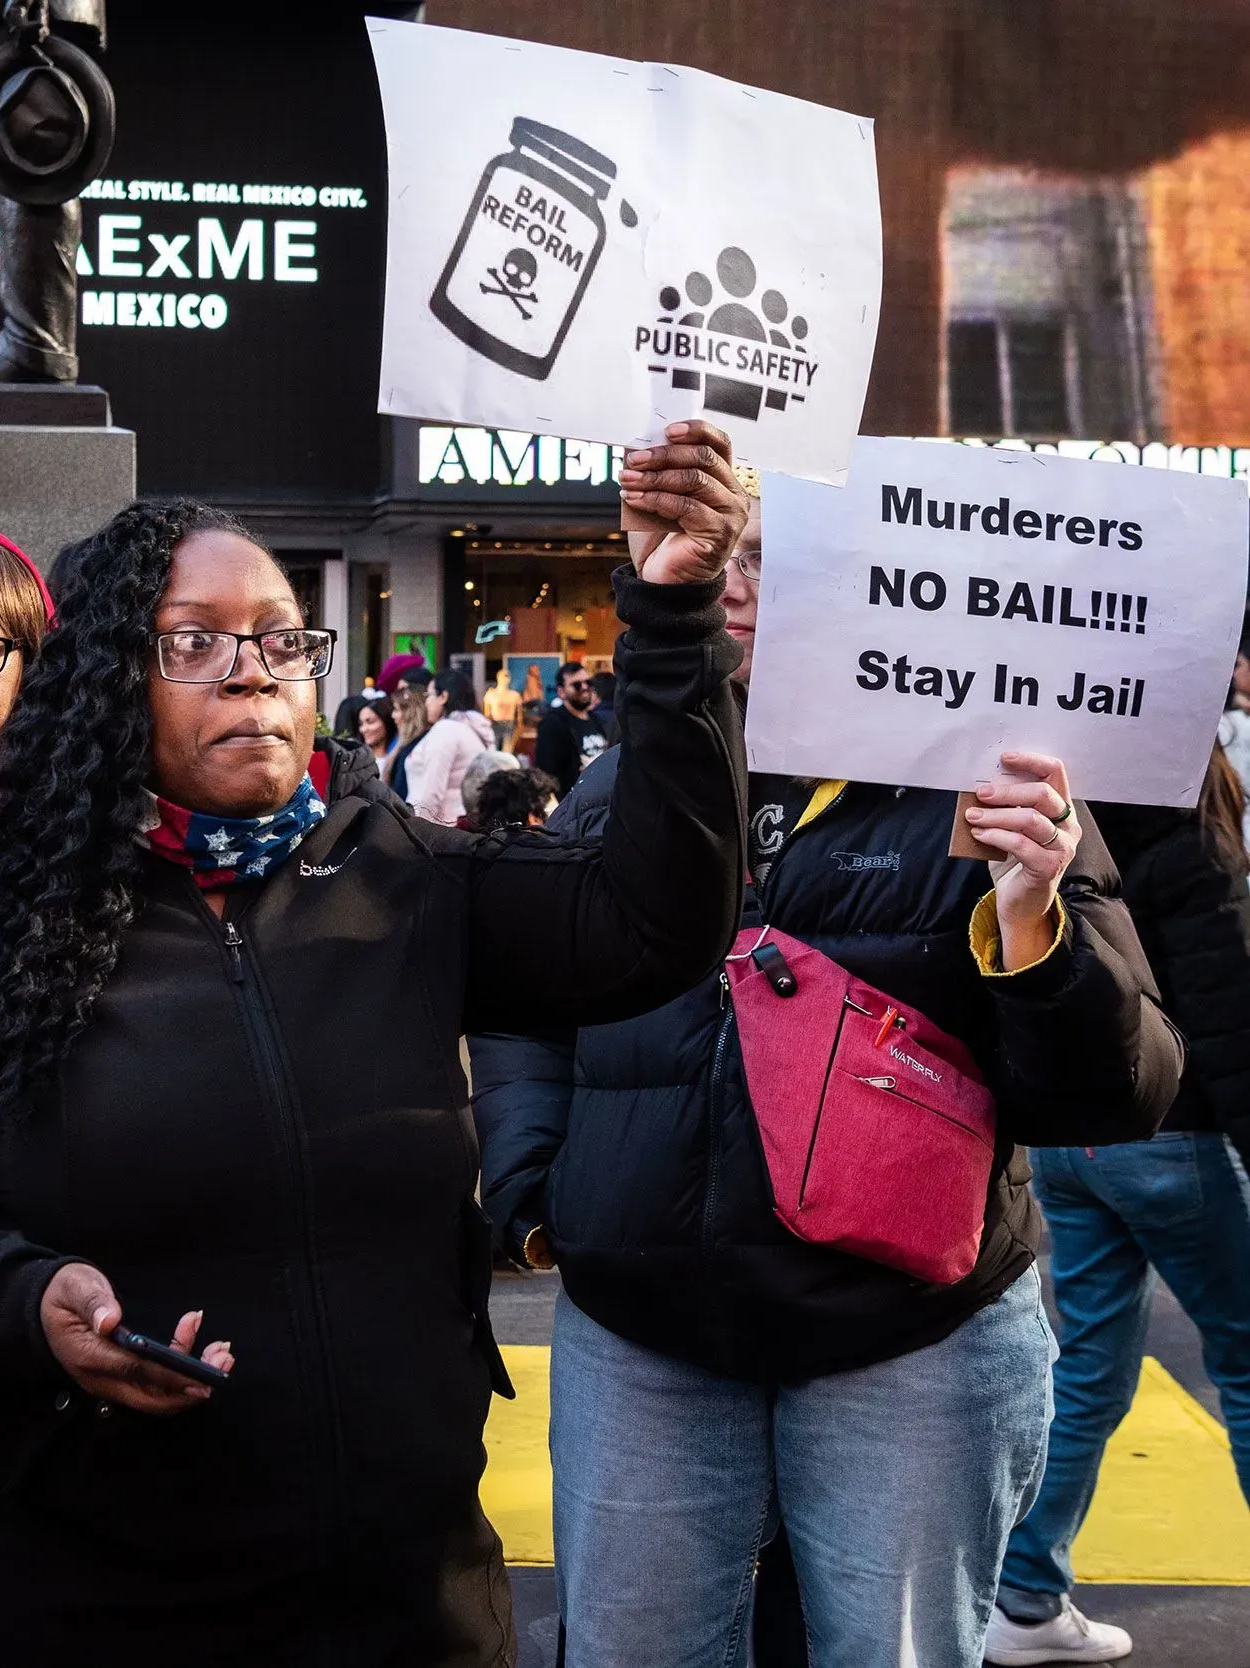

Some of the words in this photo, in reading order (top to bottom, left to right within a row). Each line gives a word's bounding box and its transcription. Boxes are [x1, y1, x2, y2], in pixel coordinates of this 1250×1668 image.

[127, 180, 191, 202] STYLE.
[192, 182, 241, 204] REAL
[242, 184, 317, 207] MEXICO
[318, 186, 368, 209] CITY.
[514, 185, 568, 233] BAIL
[482, 194, 584, 273] REFORM
[81, 290, 228, 330] MEXICO
[635, 326, 730, 367] PUBLIC
[735, 344, 819, 387] SAFETY
[881, 484, 1143, 551] Murderers
[868, 565, 947, 612] NO
[966, 576, 1148, 635] BAIL!!!!
[855, 650, 976, 710] Stay
[993, 663, 1039, 707] In
[1056, 672, 1146, 718] Jail
[890, 1045, 943, 1083] WATERFLY
